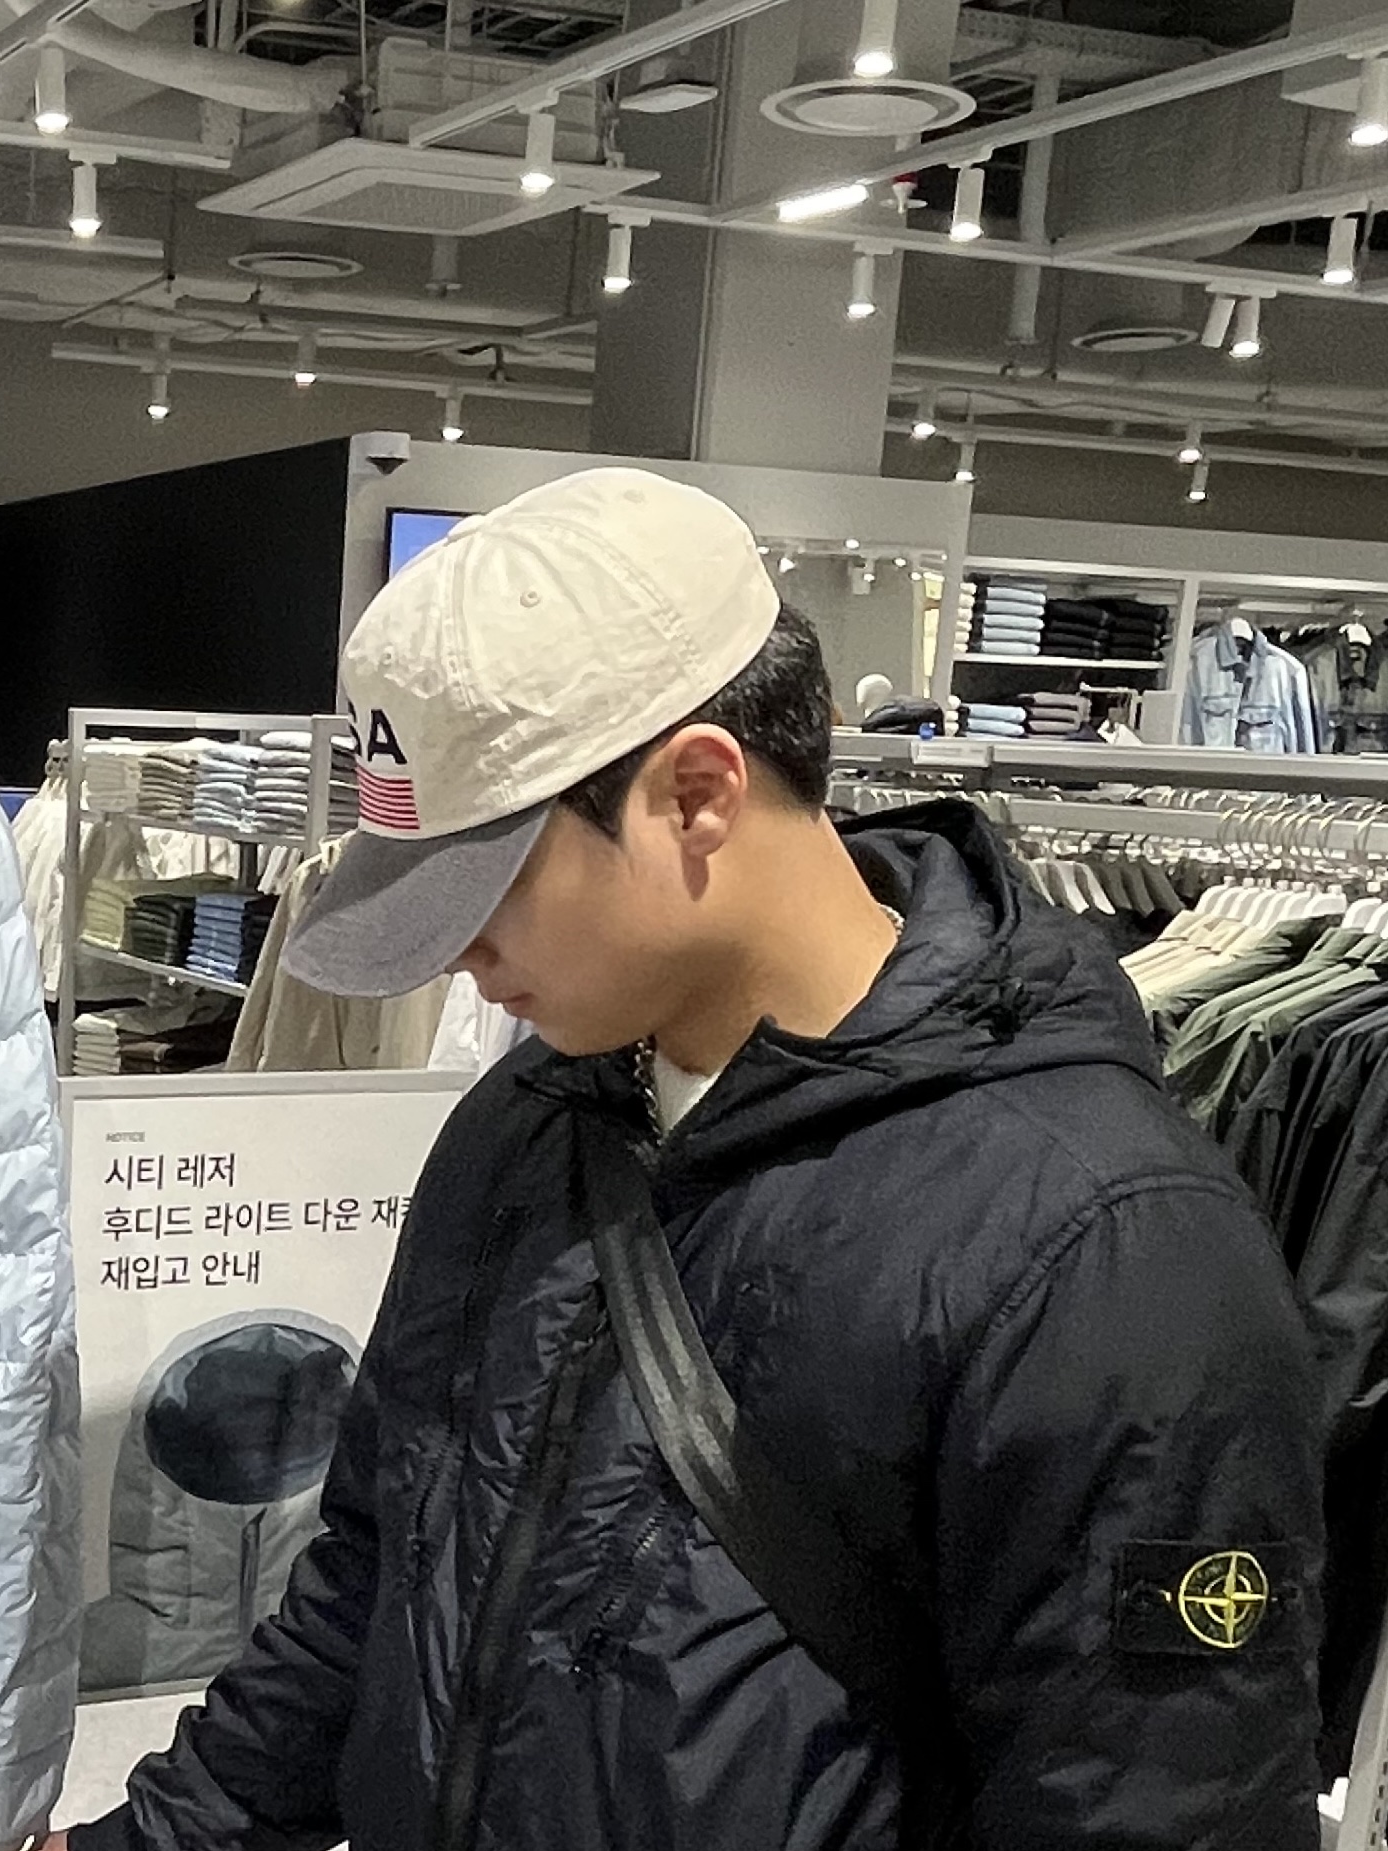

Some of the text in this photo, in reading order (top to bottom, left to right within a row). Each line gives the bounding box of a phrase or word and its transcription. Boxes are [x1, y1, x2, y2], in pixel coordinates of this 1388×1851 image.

[104, 1152, 236, 1191] 시티 레저
[102, 1203, 194, 1243] 후디드
[204, 1199, 293, 1237] 라이트
[304, 1197, 362, 1233] 다운
[100, 1250, 262, 1291] 재입고 안내
